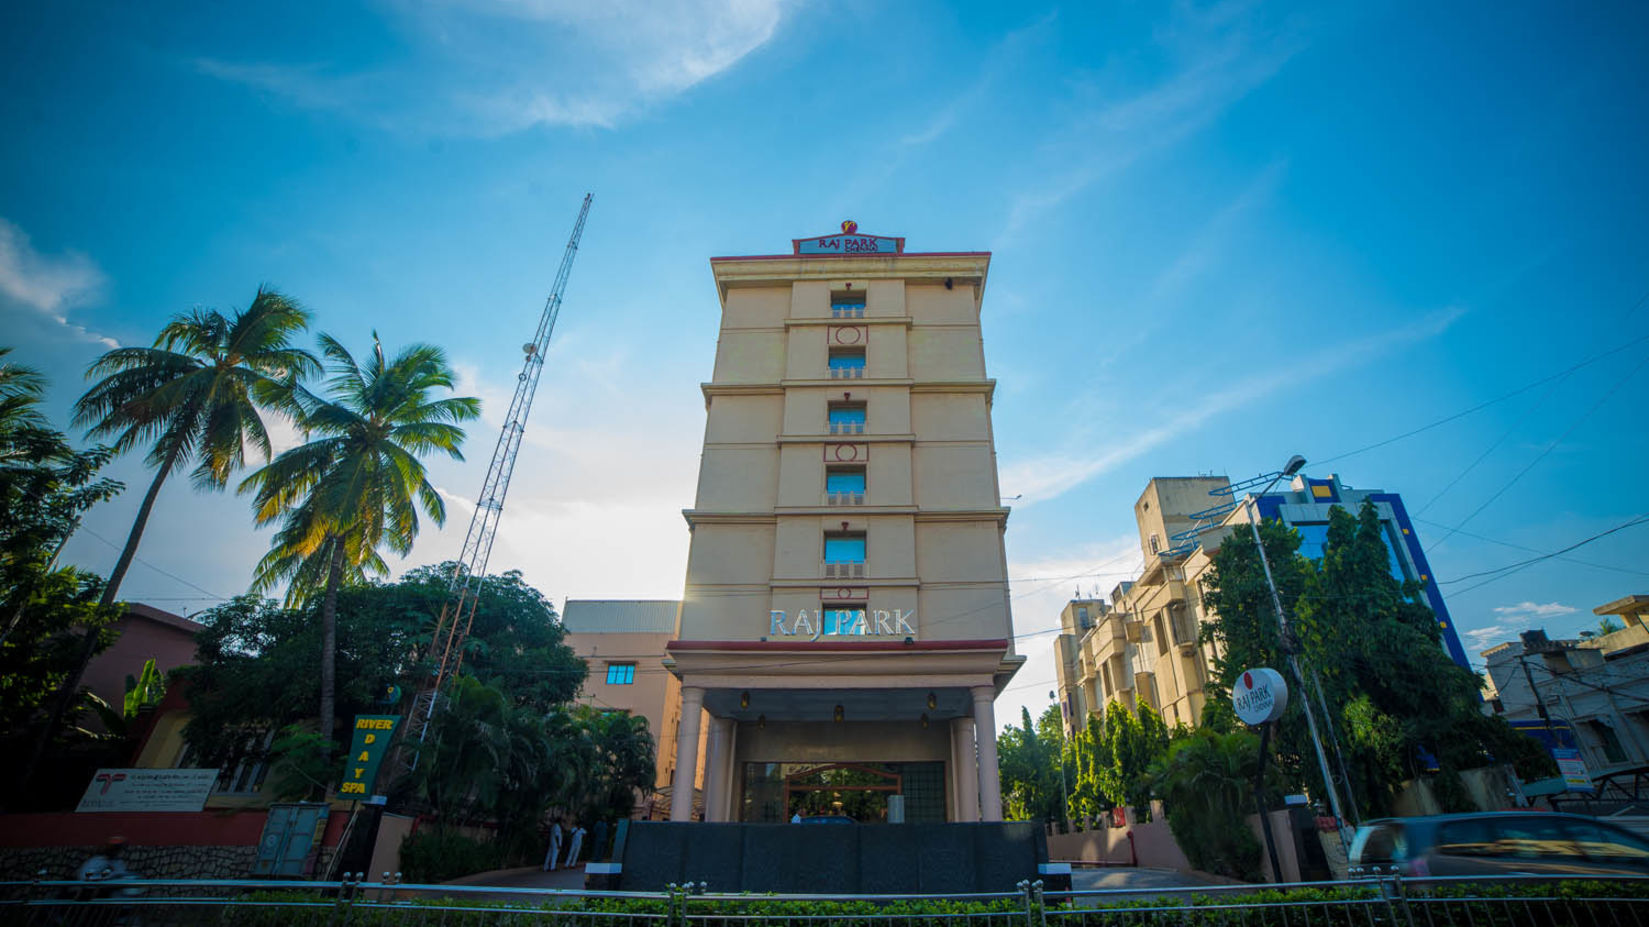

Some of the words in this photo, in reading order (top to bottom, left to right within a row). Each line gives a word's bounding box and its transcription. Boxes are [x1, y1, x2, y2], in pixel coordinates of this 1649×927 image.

[818, 239, 840, 250] RAJ
[844, 238, 878, 248] PARK
[769, 609, 821, 642] RAJ
[835, 609, 916, 636] PARK
[1236, 694, 1251, 712] RAJ
[1250, 683, 1271, 704] PARK
[356, 718, 394, 730] RIVER
[341, 782, 366, 794] SPA
